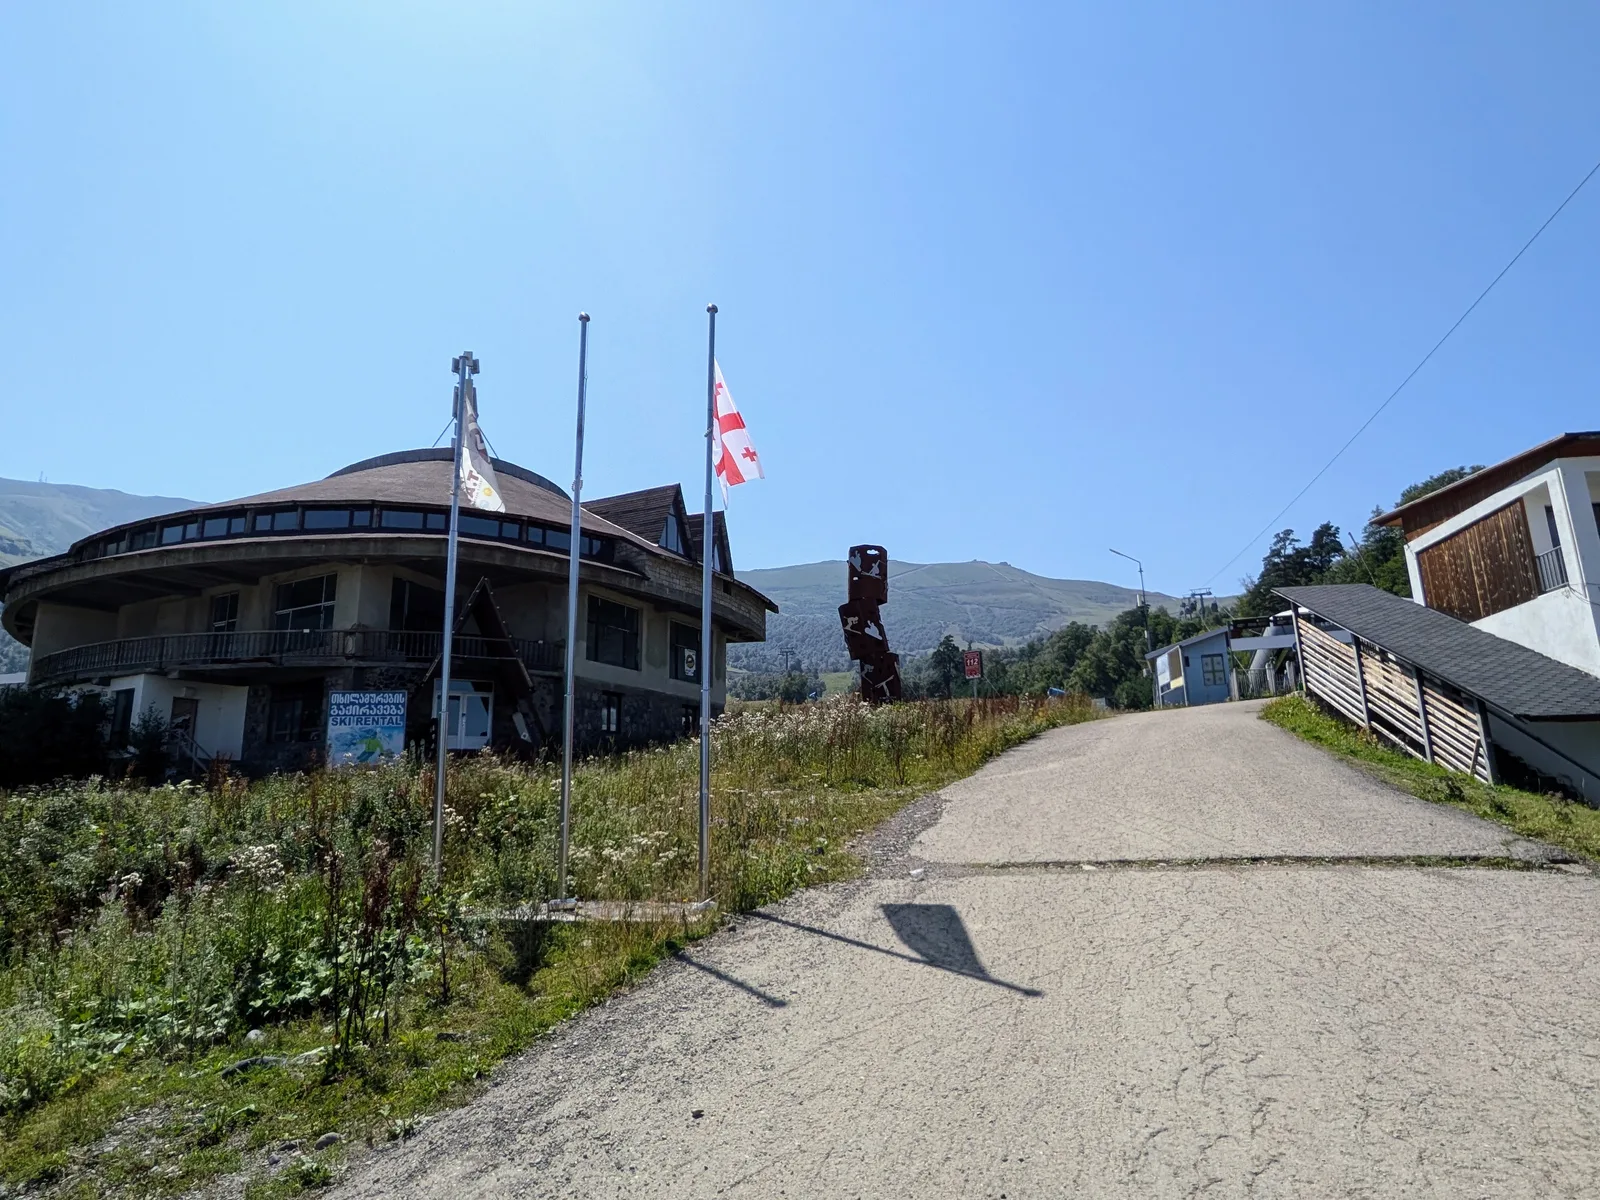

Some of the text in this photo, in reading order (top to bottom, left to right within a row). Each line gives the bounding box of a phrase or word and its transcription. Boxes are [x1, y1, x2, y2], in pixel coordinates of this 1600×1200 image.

[966, 658, 979, 666] 112
[331, 693, 405, 704] თხილამურების
[330, 704, 404, 715] გაქირავება
[331, 716, 402, 726] SKI RENTAL
